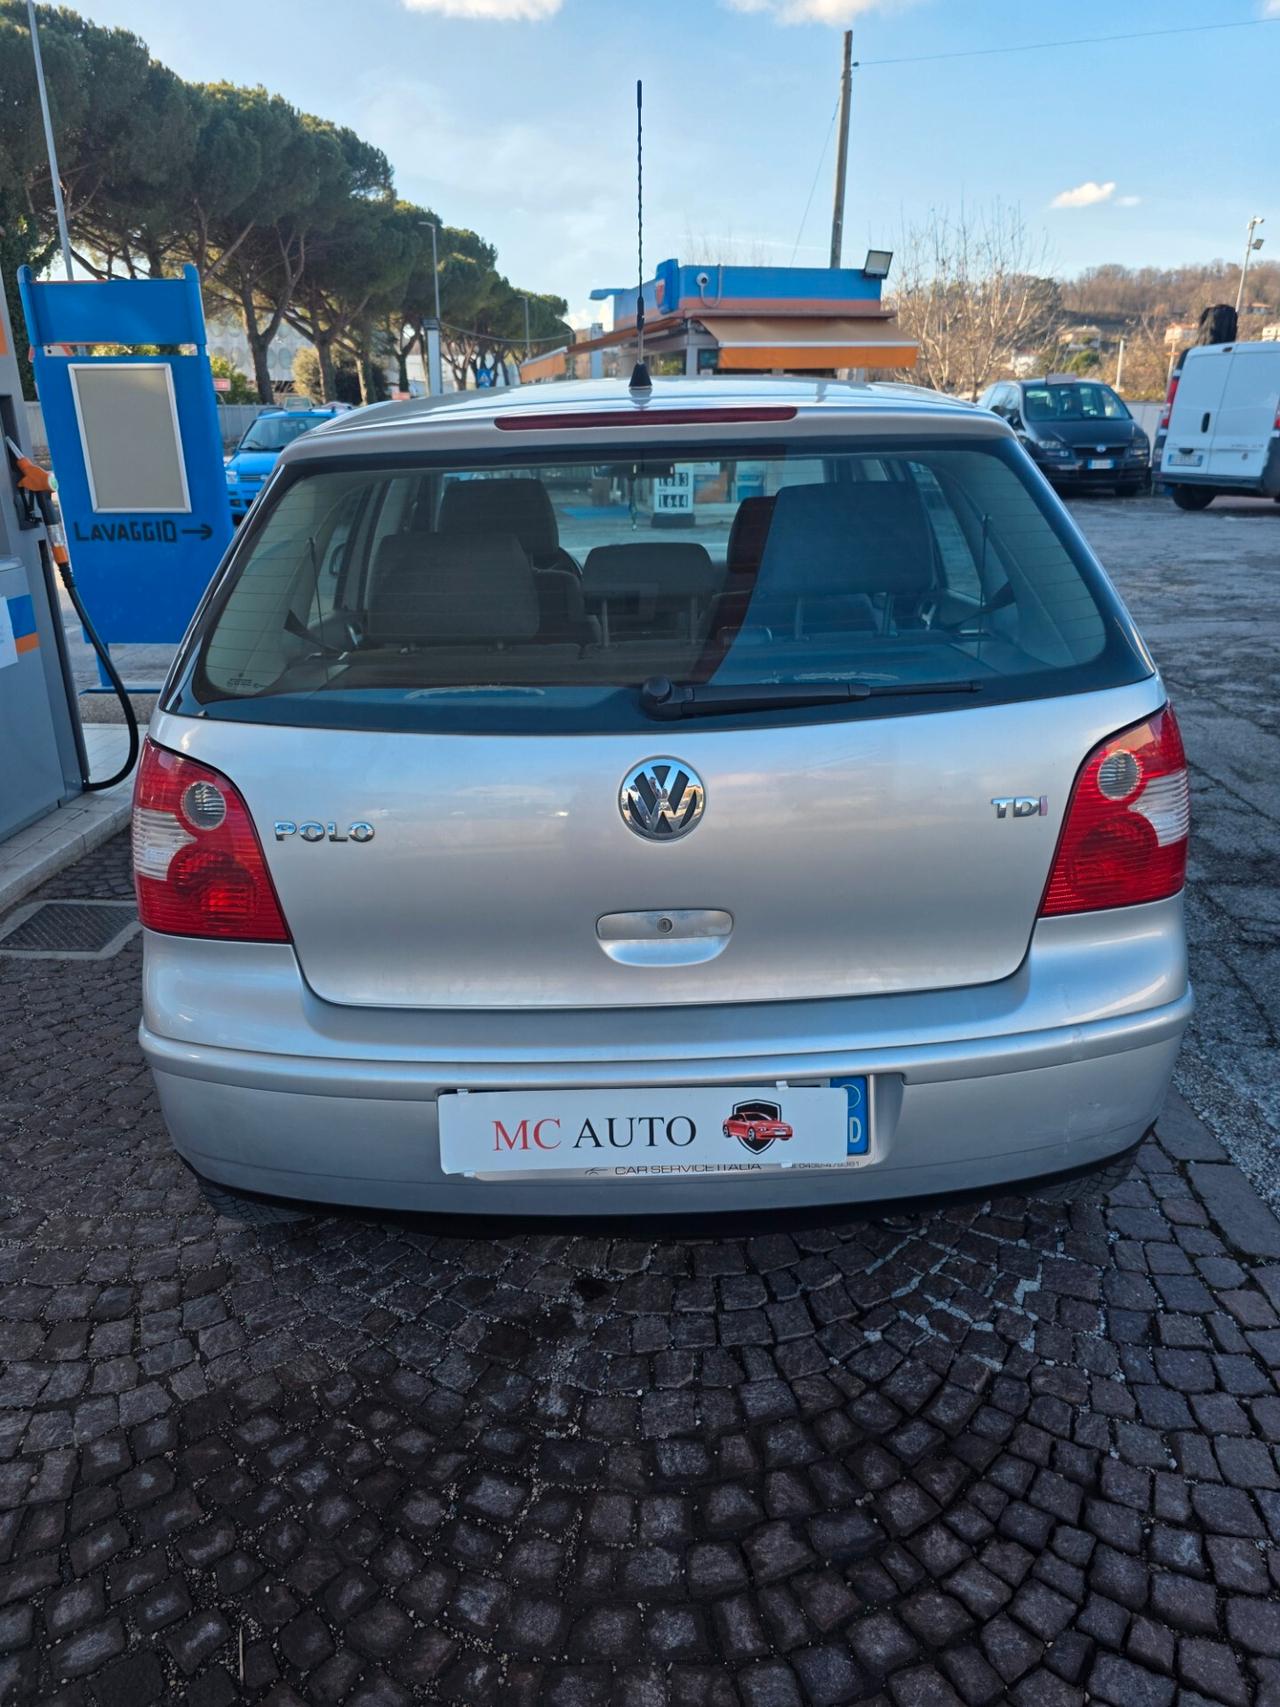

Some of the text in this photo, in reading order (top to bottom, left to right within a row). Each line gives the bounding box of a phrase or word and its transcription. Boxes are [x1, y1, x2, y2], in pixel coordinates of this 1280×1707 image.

[73, 520, 178, 543] LAVAGGIO
[619, 755, 706, 842] VW
[991, 795, 1048, 818] TDI
[274, 820, 375, 842] POLO
[491, 1115, 698, 1151] MC AUTO
[615, 1162, 763, 1176] CAR SERVICE ITALIA
